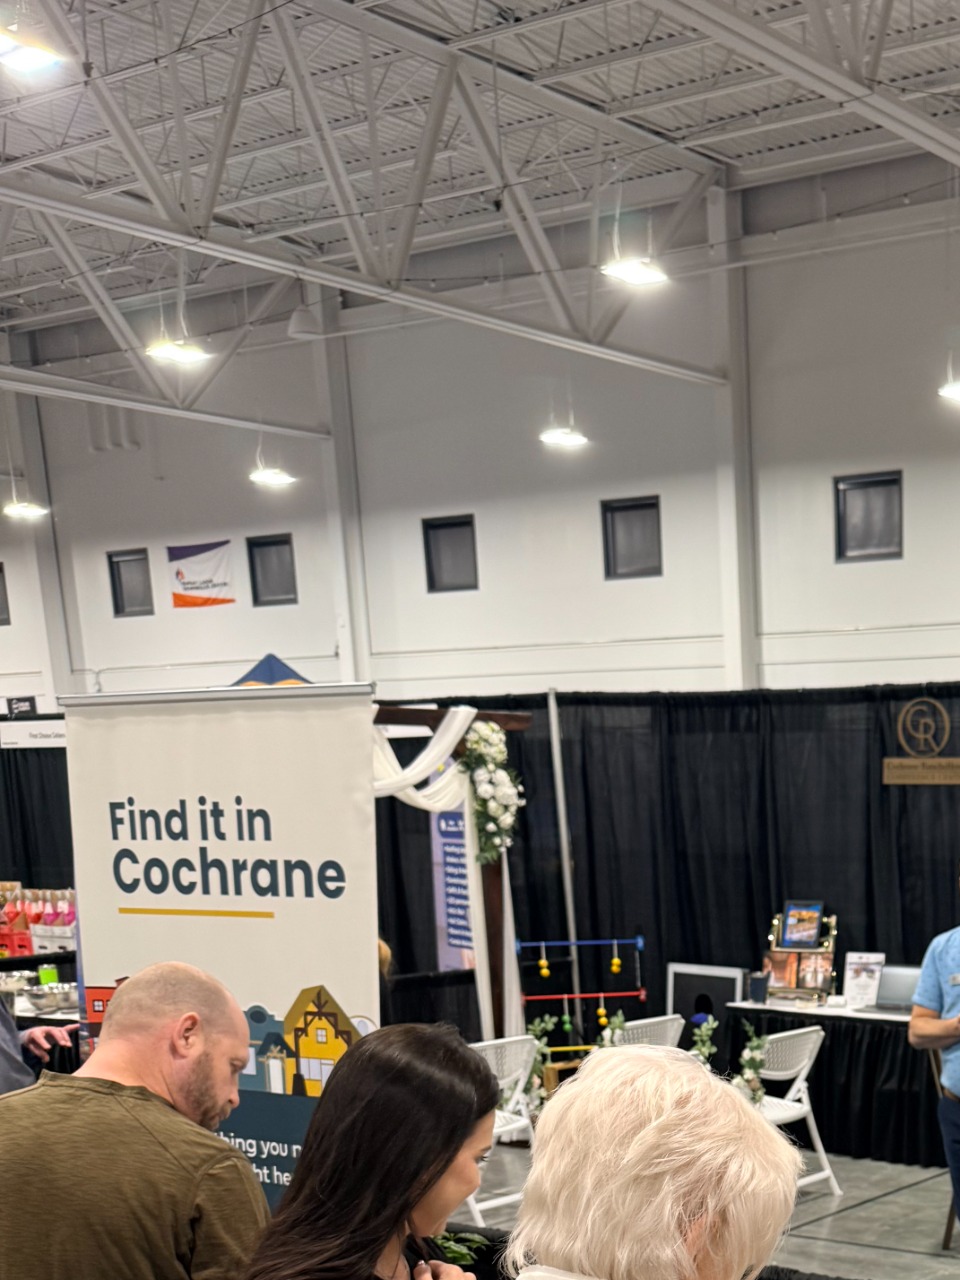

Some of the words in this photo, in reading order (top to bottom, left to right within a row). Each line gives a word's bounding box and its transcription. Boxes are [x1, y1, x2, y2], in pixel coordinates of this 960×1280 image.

[109, 796, 189, 841] Find
[198, 796, 227, 840] it
[236, 796, 272, 841] in
[113, 847, 346, 899] Cochrane
[260, 1140, 288, 1158] you
